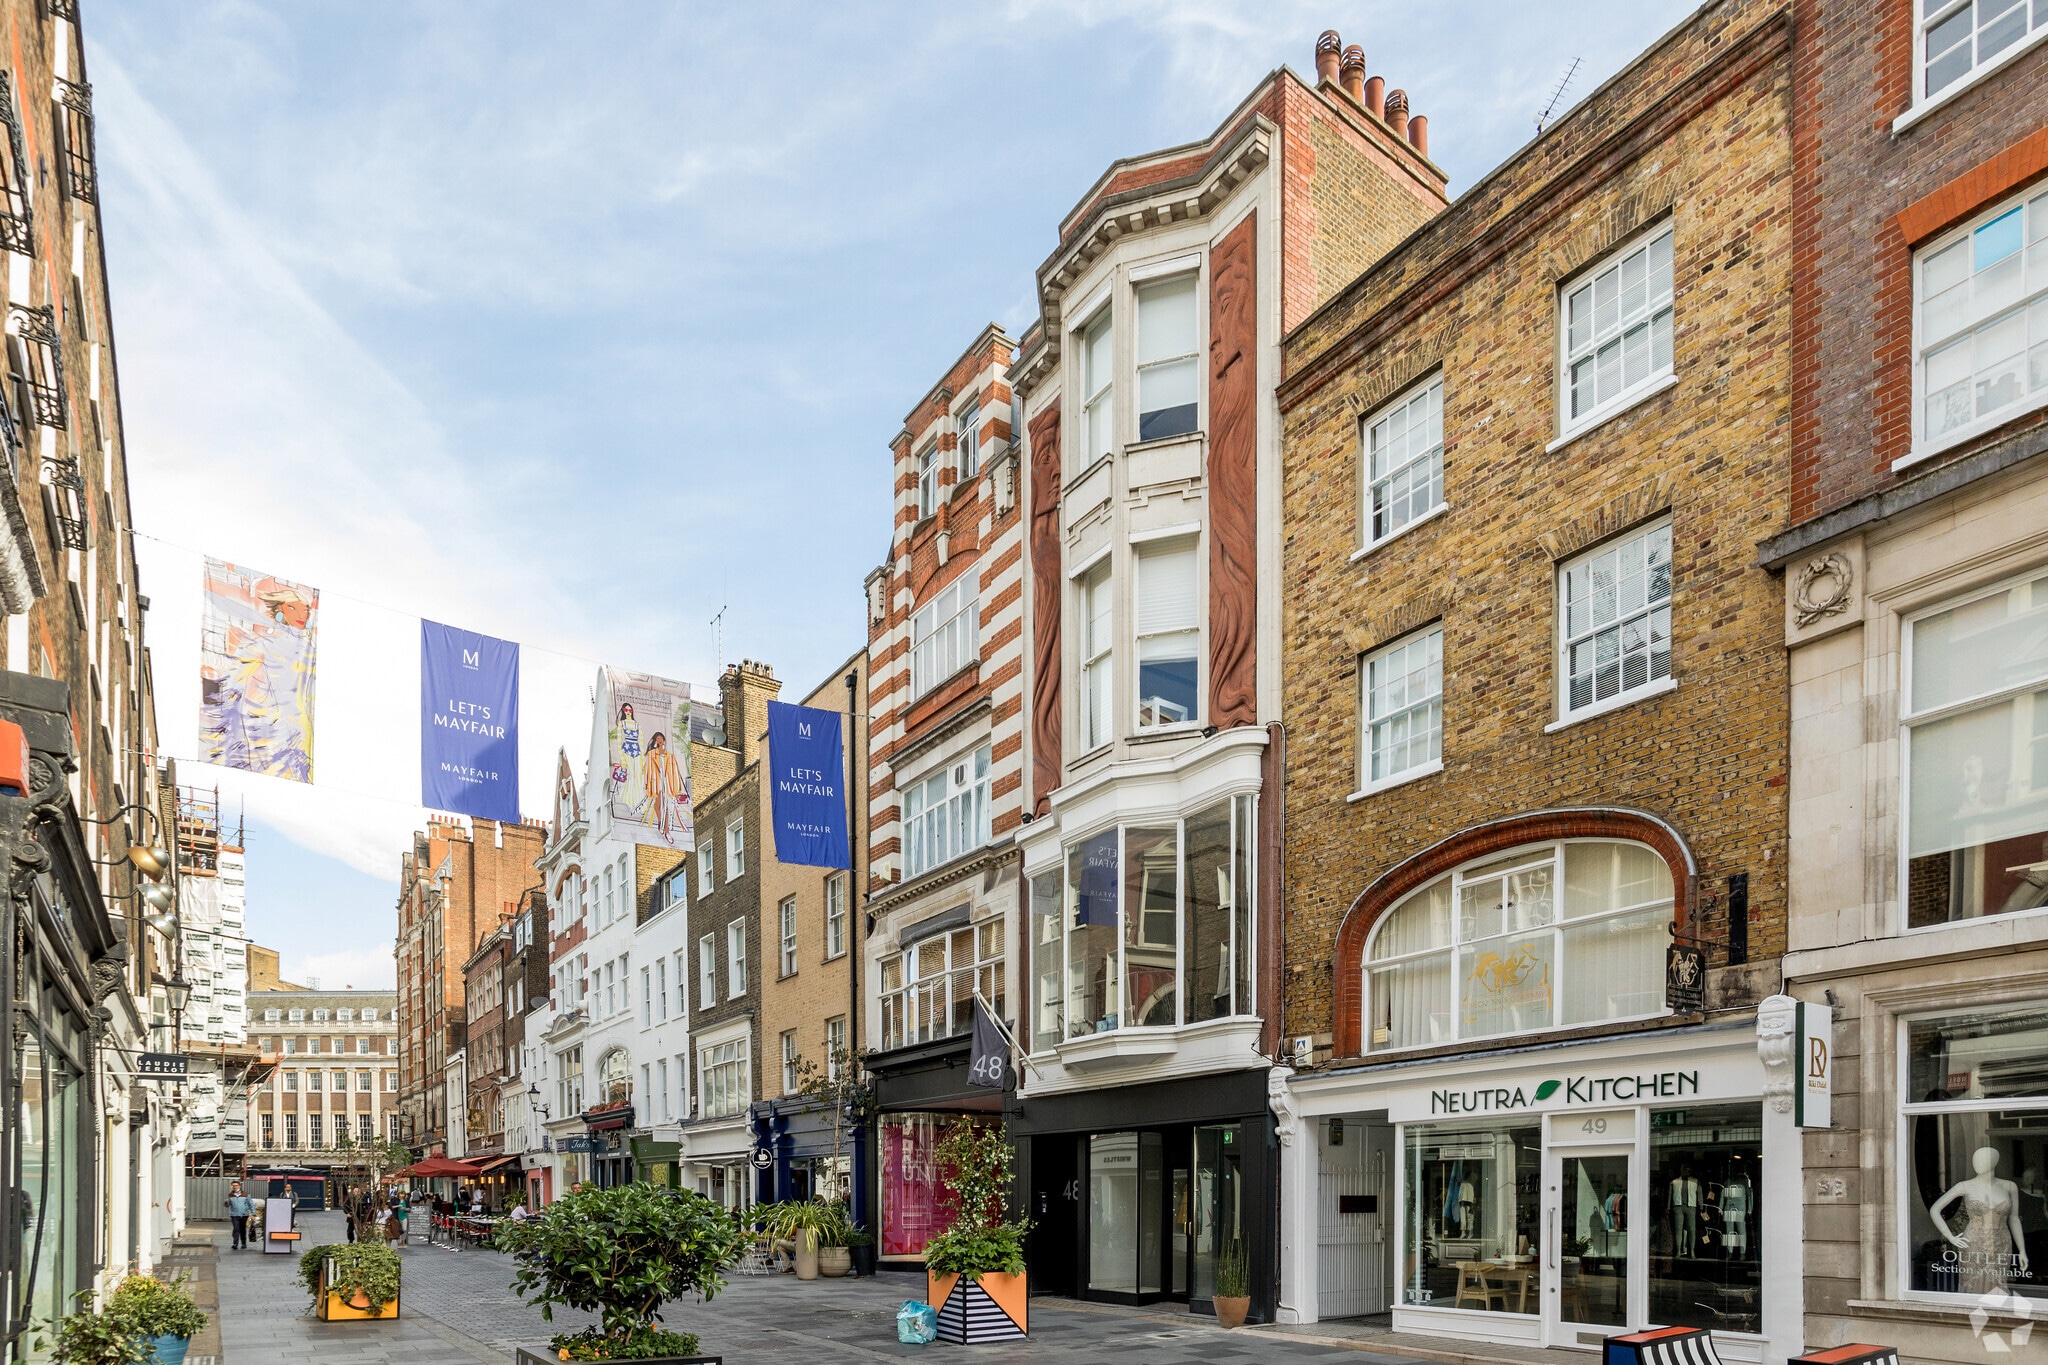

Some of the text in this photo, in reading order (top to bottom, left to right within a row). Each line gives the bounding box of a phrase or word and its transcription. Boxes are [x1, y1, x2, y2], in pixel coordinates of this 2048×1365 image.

[463, 649, 479, 667] M
[450, 699, 491, 719] LET'S
[434, 713, 505, 739] MAYFAIR
[799, 722, 811, 737] M
[441, 762, 499, 781] MAYFAIR
[458, 776, 483, 784] LONDON
[790, 767, 822, 782] LET'S
[780, 780, 834, 797] MAYFAIR
[787, 822, 831, 834] MAYFAIR
[973, 1054, 1002, 1080] 48
[1581, 1117, 1607, 1135] 49
[1942, 1250, 2020, 1266] OUTLET
[1931, 1262, 2033, 1278] Section available
